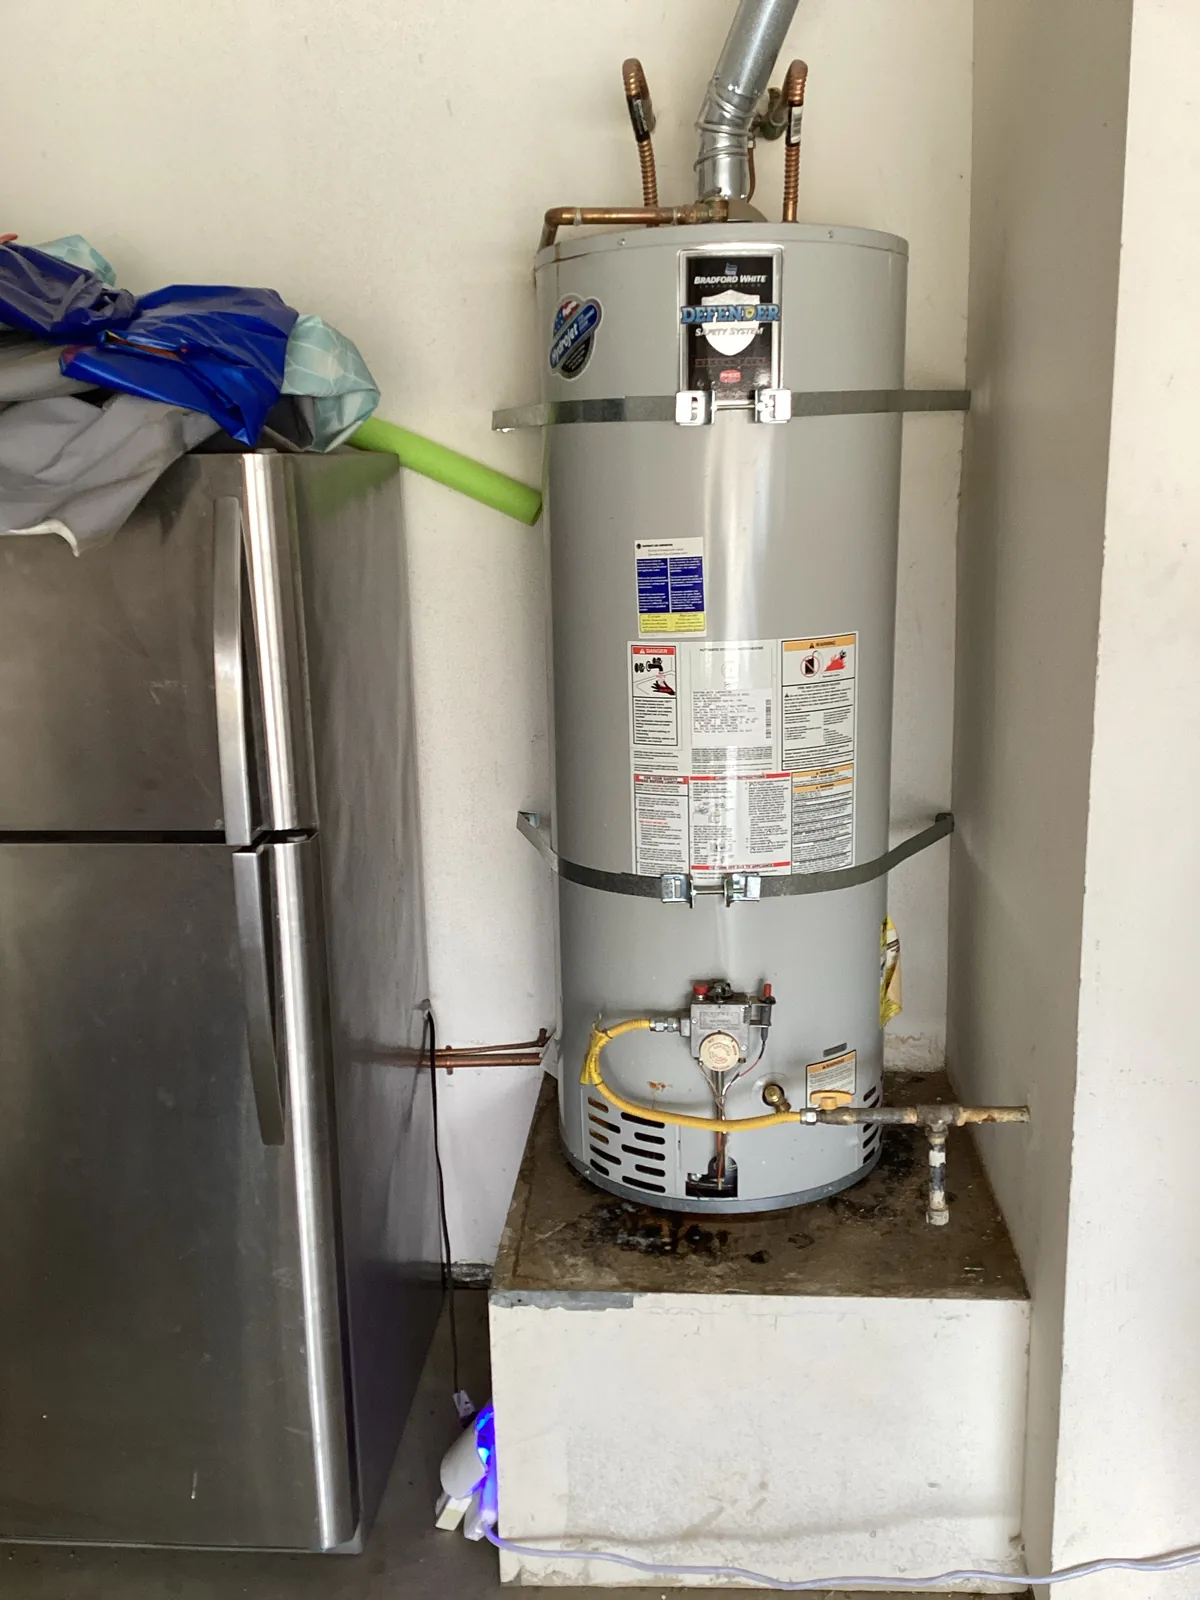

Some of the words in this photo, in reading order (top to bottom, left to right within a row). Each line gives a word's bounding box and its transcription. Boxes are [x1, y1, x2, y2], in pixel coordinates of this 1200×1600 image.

[694, 275, 738, 285] BRADFORD
[740, 274, 767, 284] WHITE
[681, 304, 779, 324] DEFENDER
[695, 327, 728, 337] SAFETY
[729, 326, 764, 336] SYSTEM
